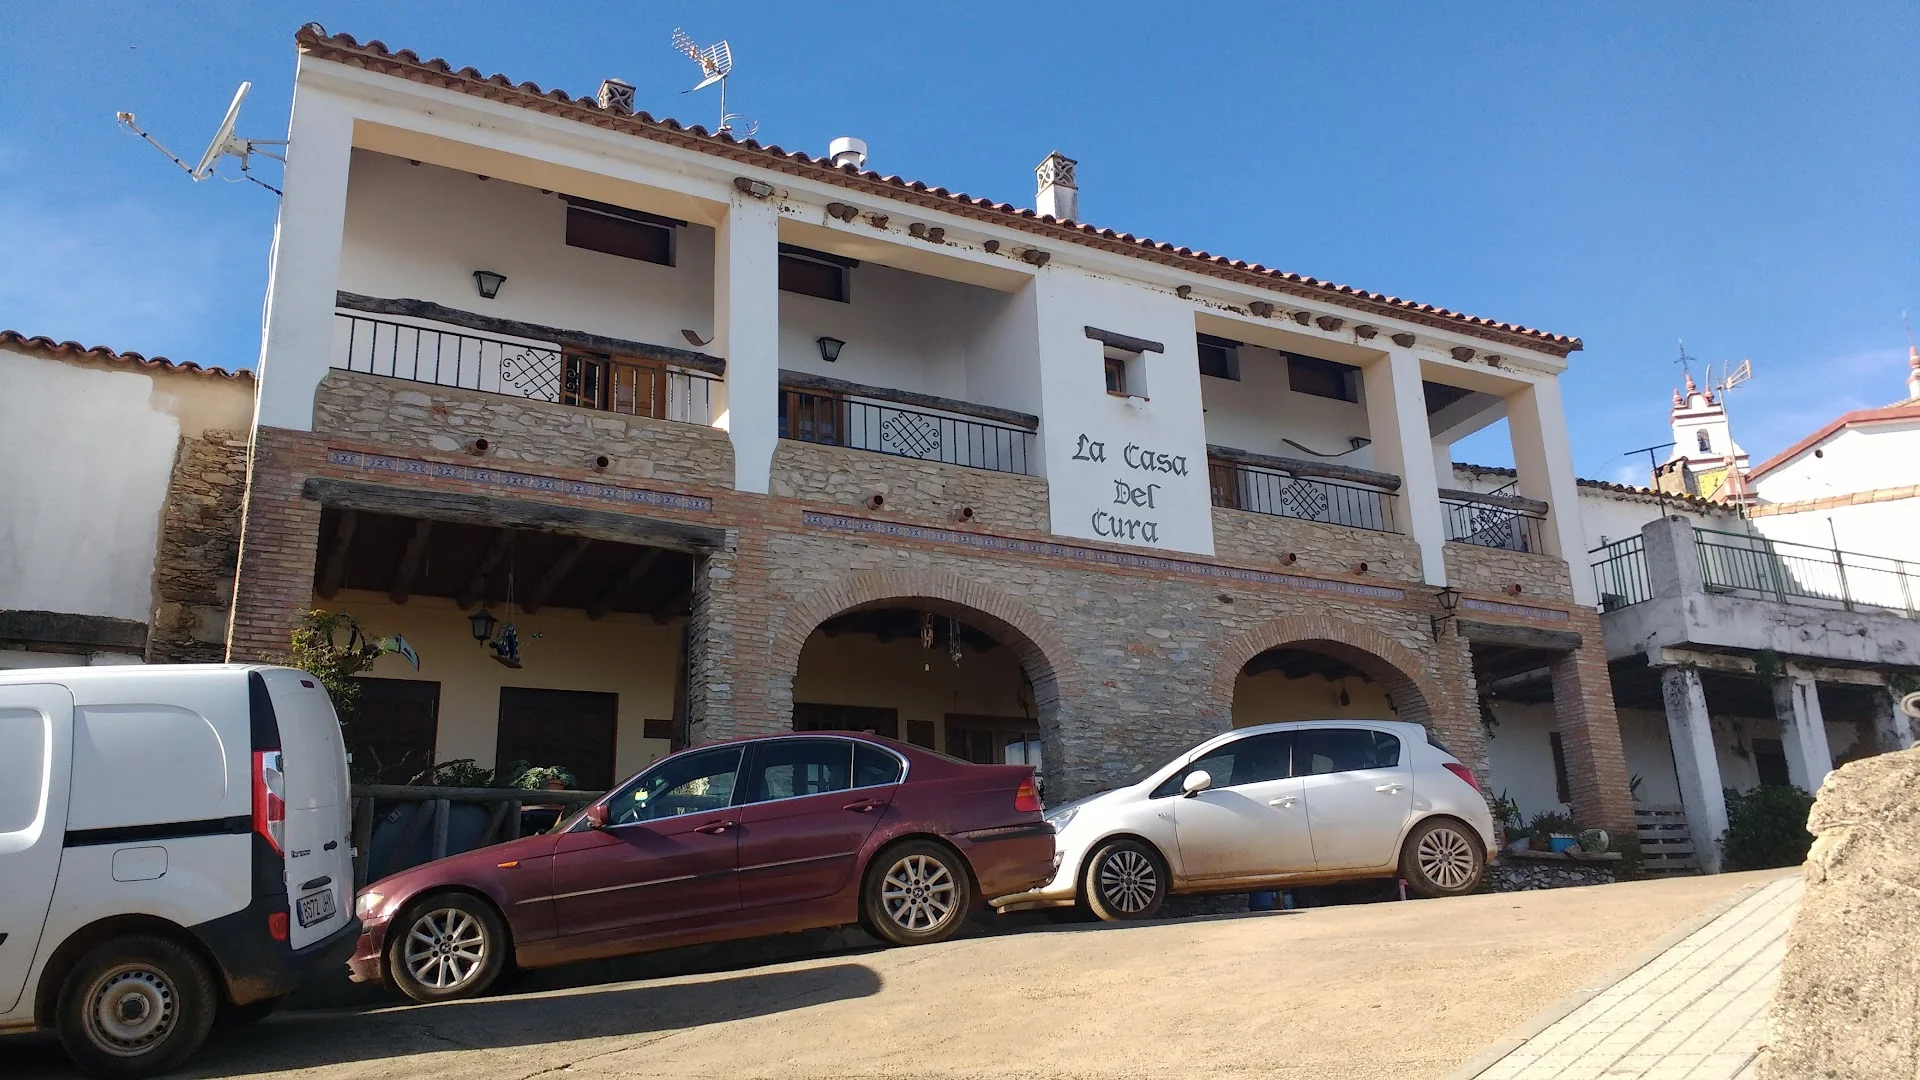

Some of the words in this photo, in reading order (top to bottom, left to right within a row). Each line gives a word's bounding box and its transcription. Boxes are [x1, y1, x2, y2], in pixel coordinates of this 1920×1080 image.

[1072, 433, 1107, 463] La
[1123, 442, 1189, 477] Casa
[1113, 478, 1162, 509] Del
[1091, 508, 1160, 544] Cura
